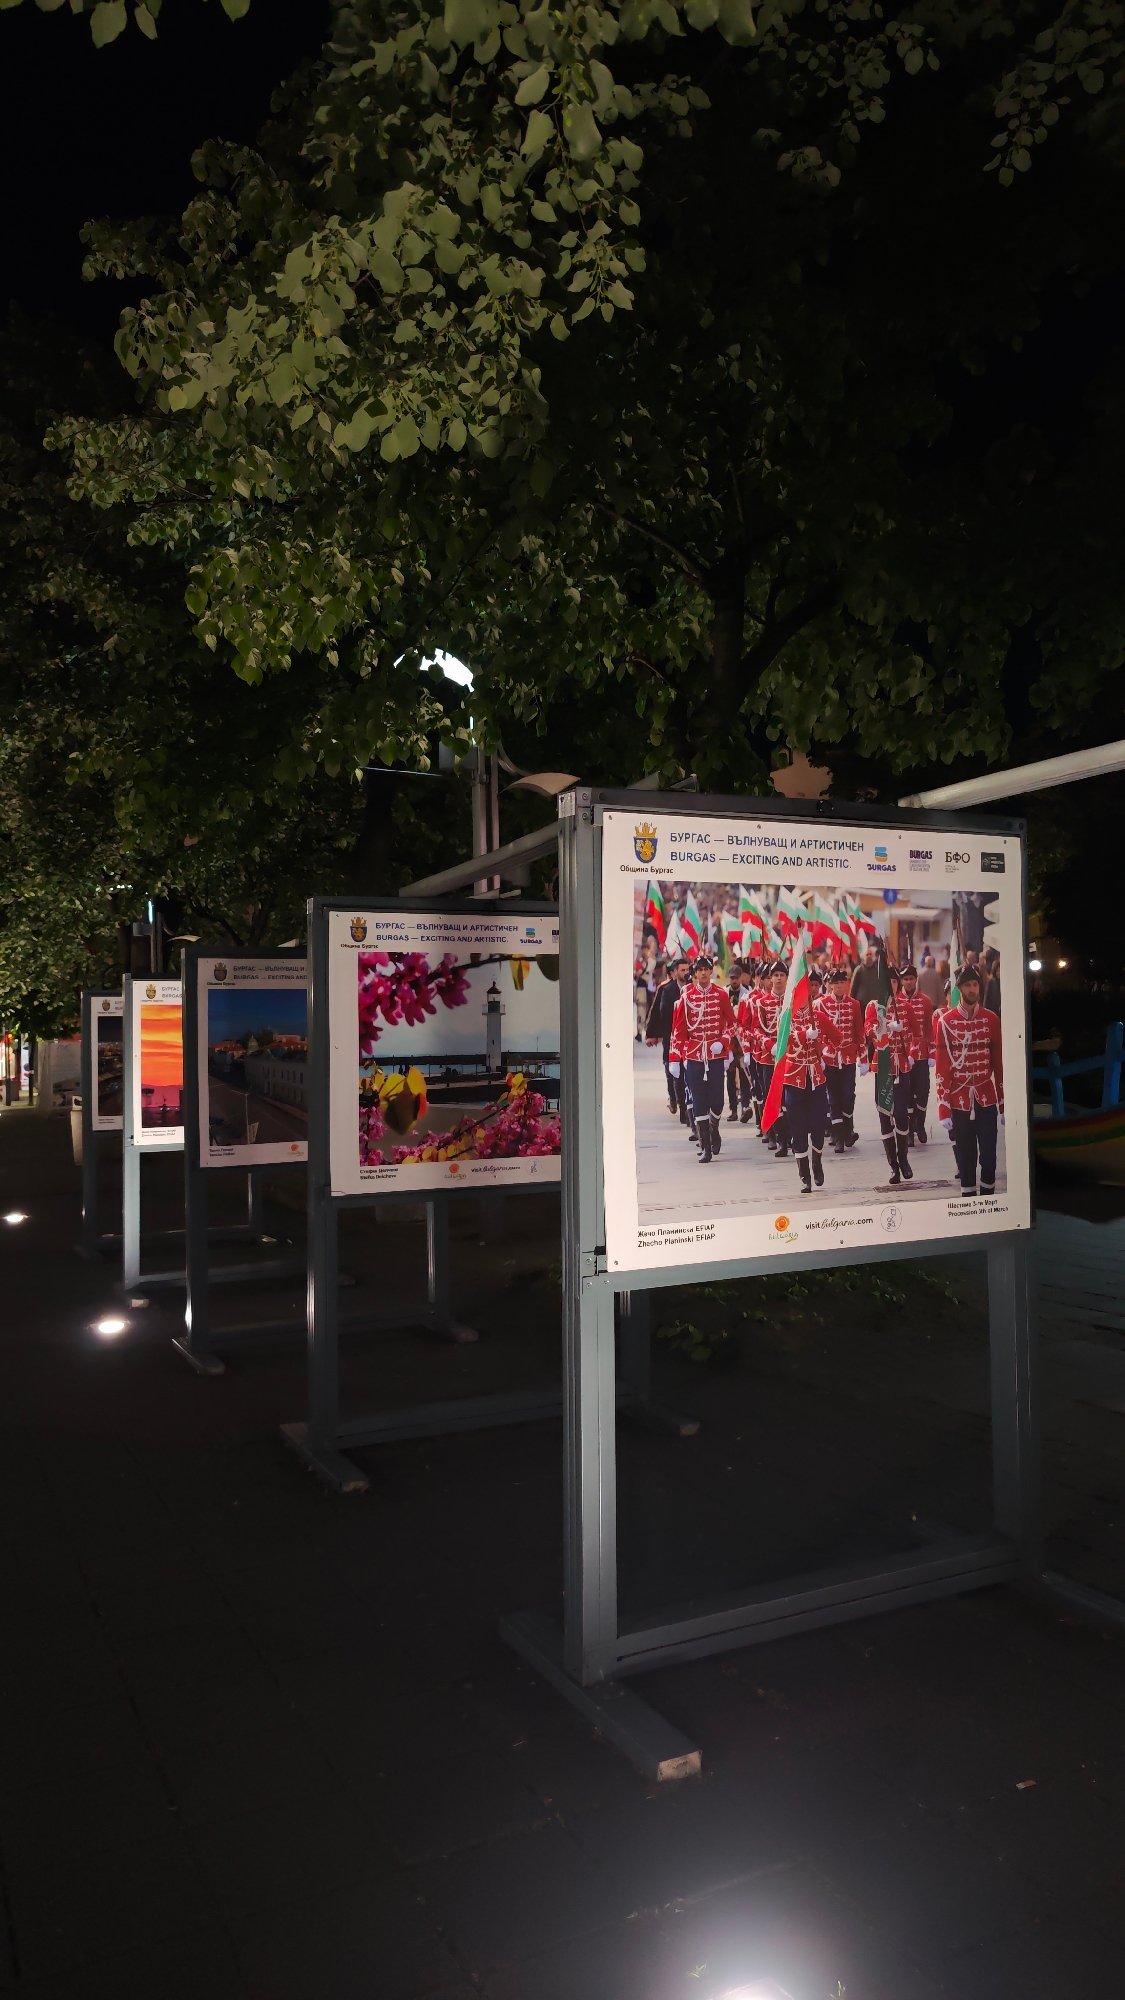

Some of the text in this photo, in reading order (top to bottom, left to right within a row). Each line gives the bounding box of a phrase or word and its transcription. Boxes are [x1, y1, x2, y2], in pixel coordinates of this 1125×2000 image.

[670, 832, 711, 844] БУРГАС
[727, 835, 788, 849] ВЪЛНУВАЩ
[790, 838, 797, 849] И
[800, 839, 864, 852] АРТИСТИЧЕН
[670, 851, 716, 864] BURGAS
[732, 854, 779, 866] EXCITING
[782, 856, 803, 867] AND
[805, 857, 852, 869] ARTISTIC.
[909, 850, 933, 860] BURGAS
[945, 851, 971, 864] БФО
[620, 864, 674, 875] Община Бургас
[375, 922, 406, 930] БУРГАС
[416, 923, 461, 932] ВЪЛНУВАЩ
[462, 924, 468, 932] И
[470, 924, 519, 932] АРТИСТИЧЕН
[376, 934, 409, 942] BURGAS
[420, 935, 456, 943] EXCITING
[457, 935, 473, 943] AND
[695, 1223, 715, 1232] EFIAP
[664, 1235, 694, 1245] Planinski
[696, 1232, 716, 1242] EFIAP
